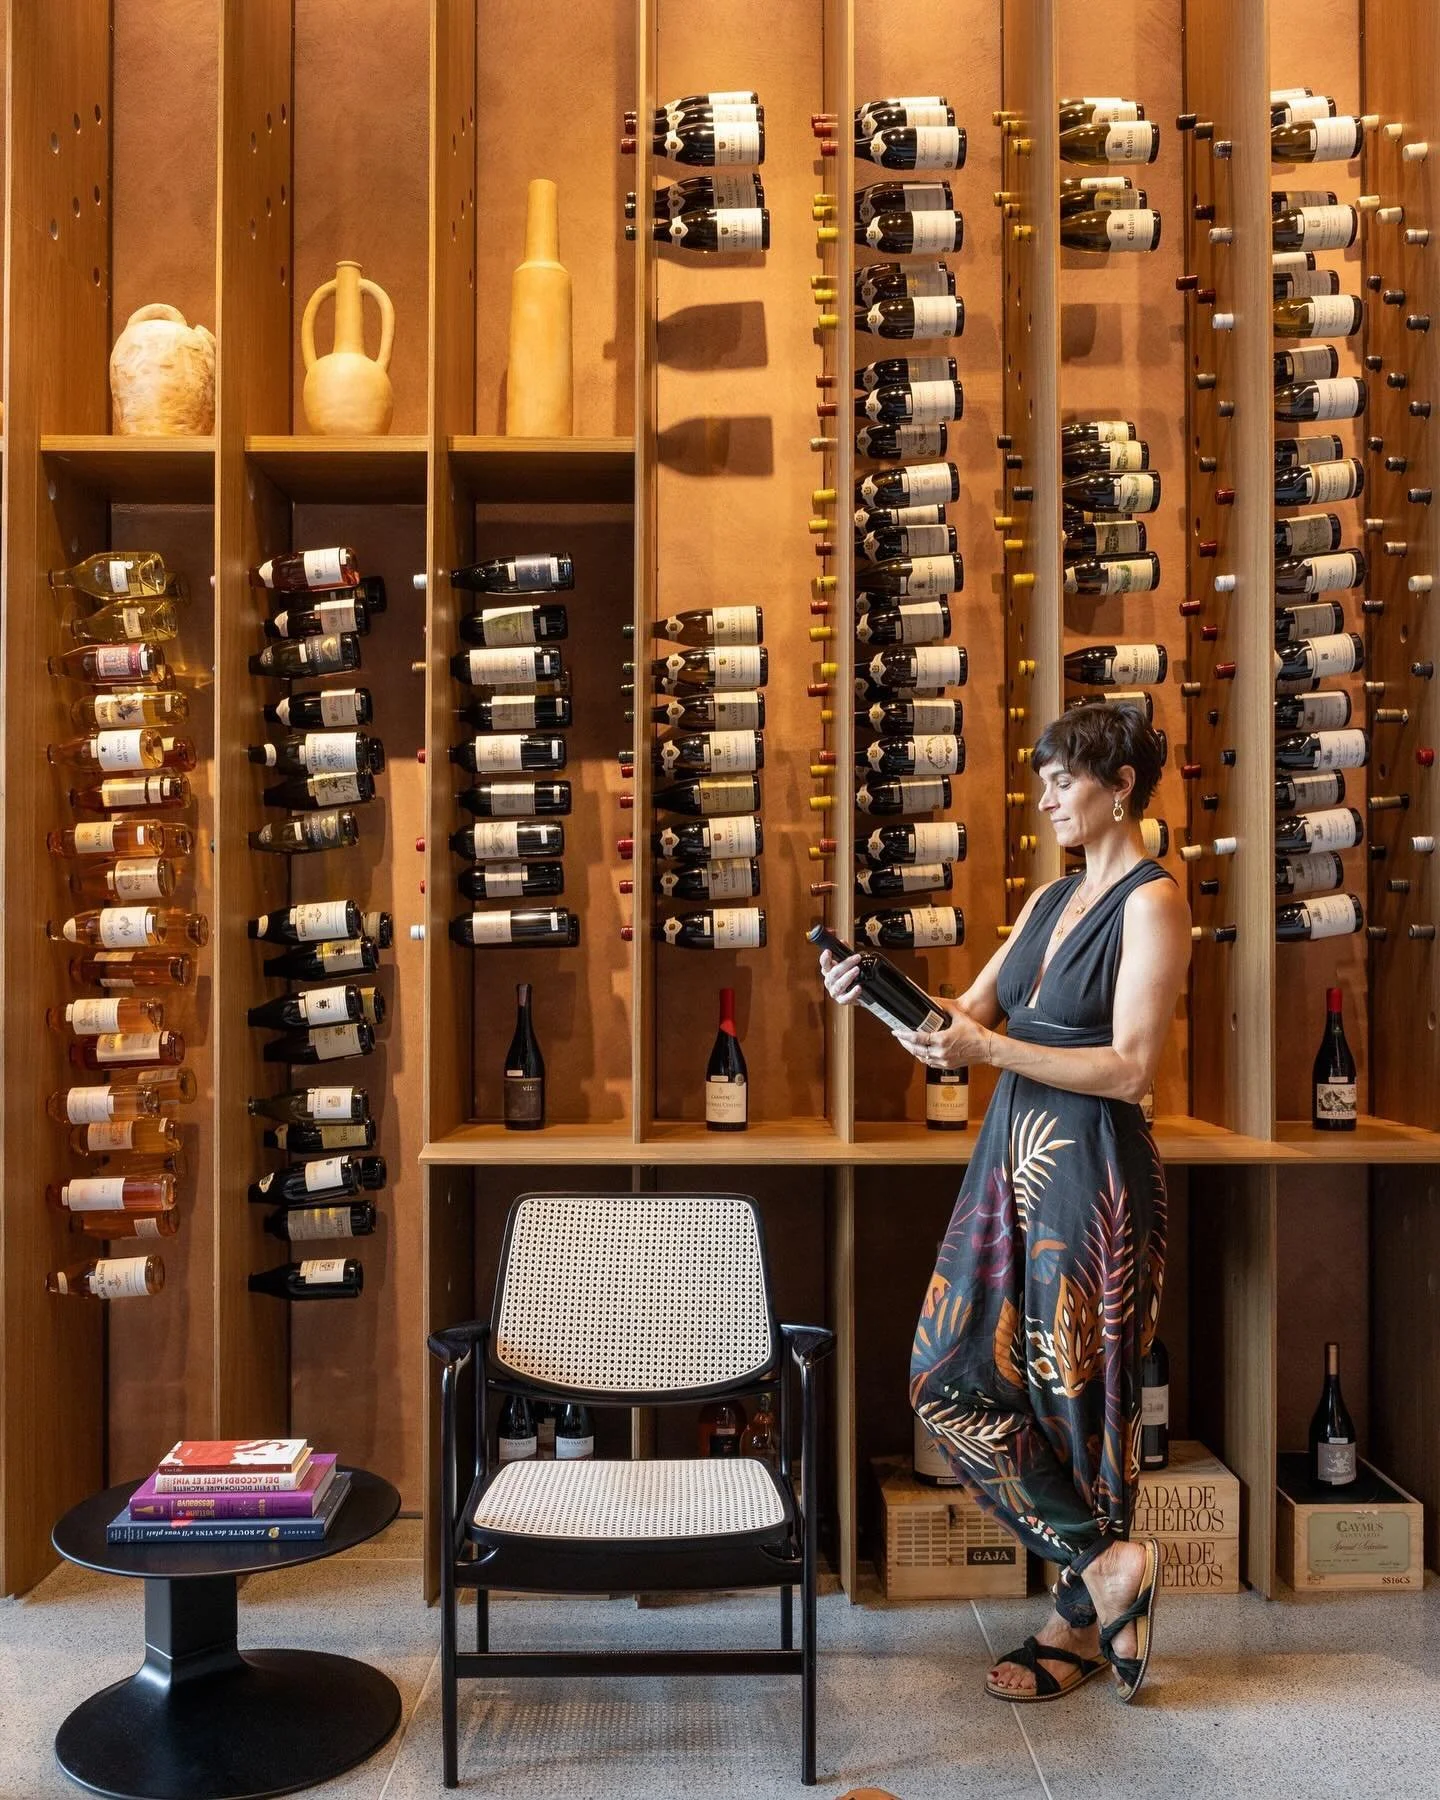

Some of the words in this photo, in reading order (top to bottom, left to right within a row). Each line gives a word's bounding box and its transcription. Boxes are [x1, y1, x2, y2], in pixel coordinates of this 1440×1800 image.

[172, 1477, 190, 1485] VINS
[192, 1477, 202, 1485] ET
[203, 1477, 223, 1485] METS
[225, 1477, 263, 1485] ACCORDS
[265, 1477, 280, 1485] DES
[1186, 1486, 1216, 1509] DE
[176, 1499, 215, 1509] desseauve
[1335, 1520, 1384, 1532] CAYMUS
[973, 1550, 1010, 1561] GAJA
[1186, 1542, 1216, 1565] DE
[1161, 1564, 1223, 1587] EIROS
[1381, 1576, 1411, 1584] SS16CS
